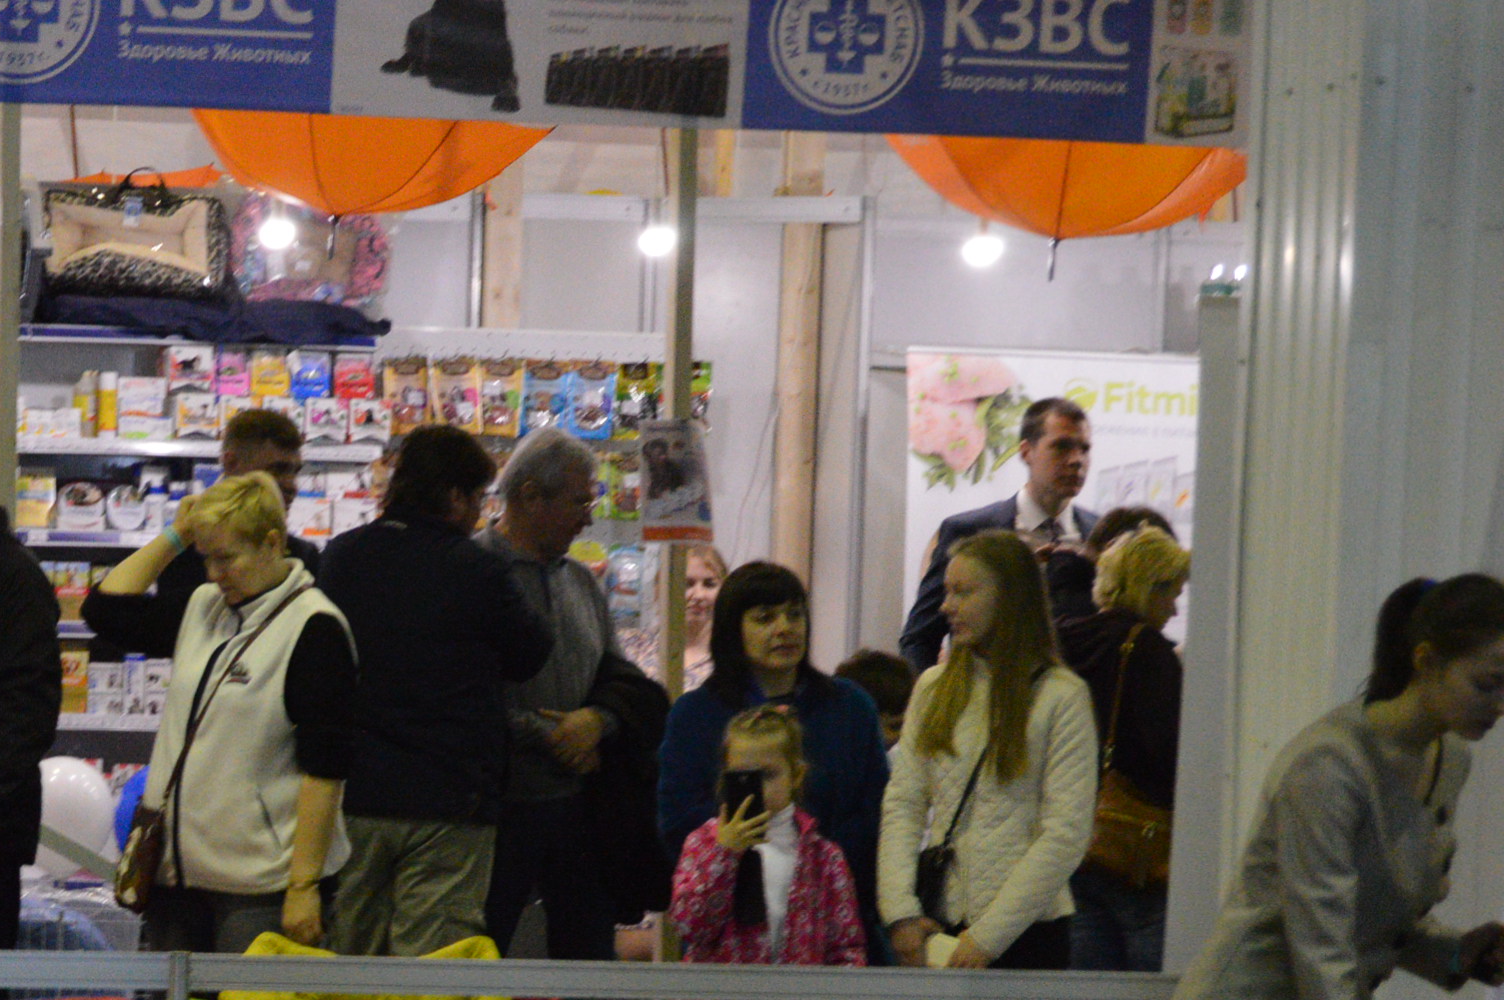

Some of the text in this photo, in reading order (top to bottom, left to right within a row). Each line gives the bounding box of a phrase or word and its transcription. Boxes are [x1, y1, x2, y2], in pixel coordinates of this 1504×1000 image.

[943, 0, 1129, 55] КЗВС
[118, 39, 311, 65] Здоровье Животных
[941, 70, 1128, 95] Здоровье Животных
